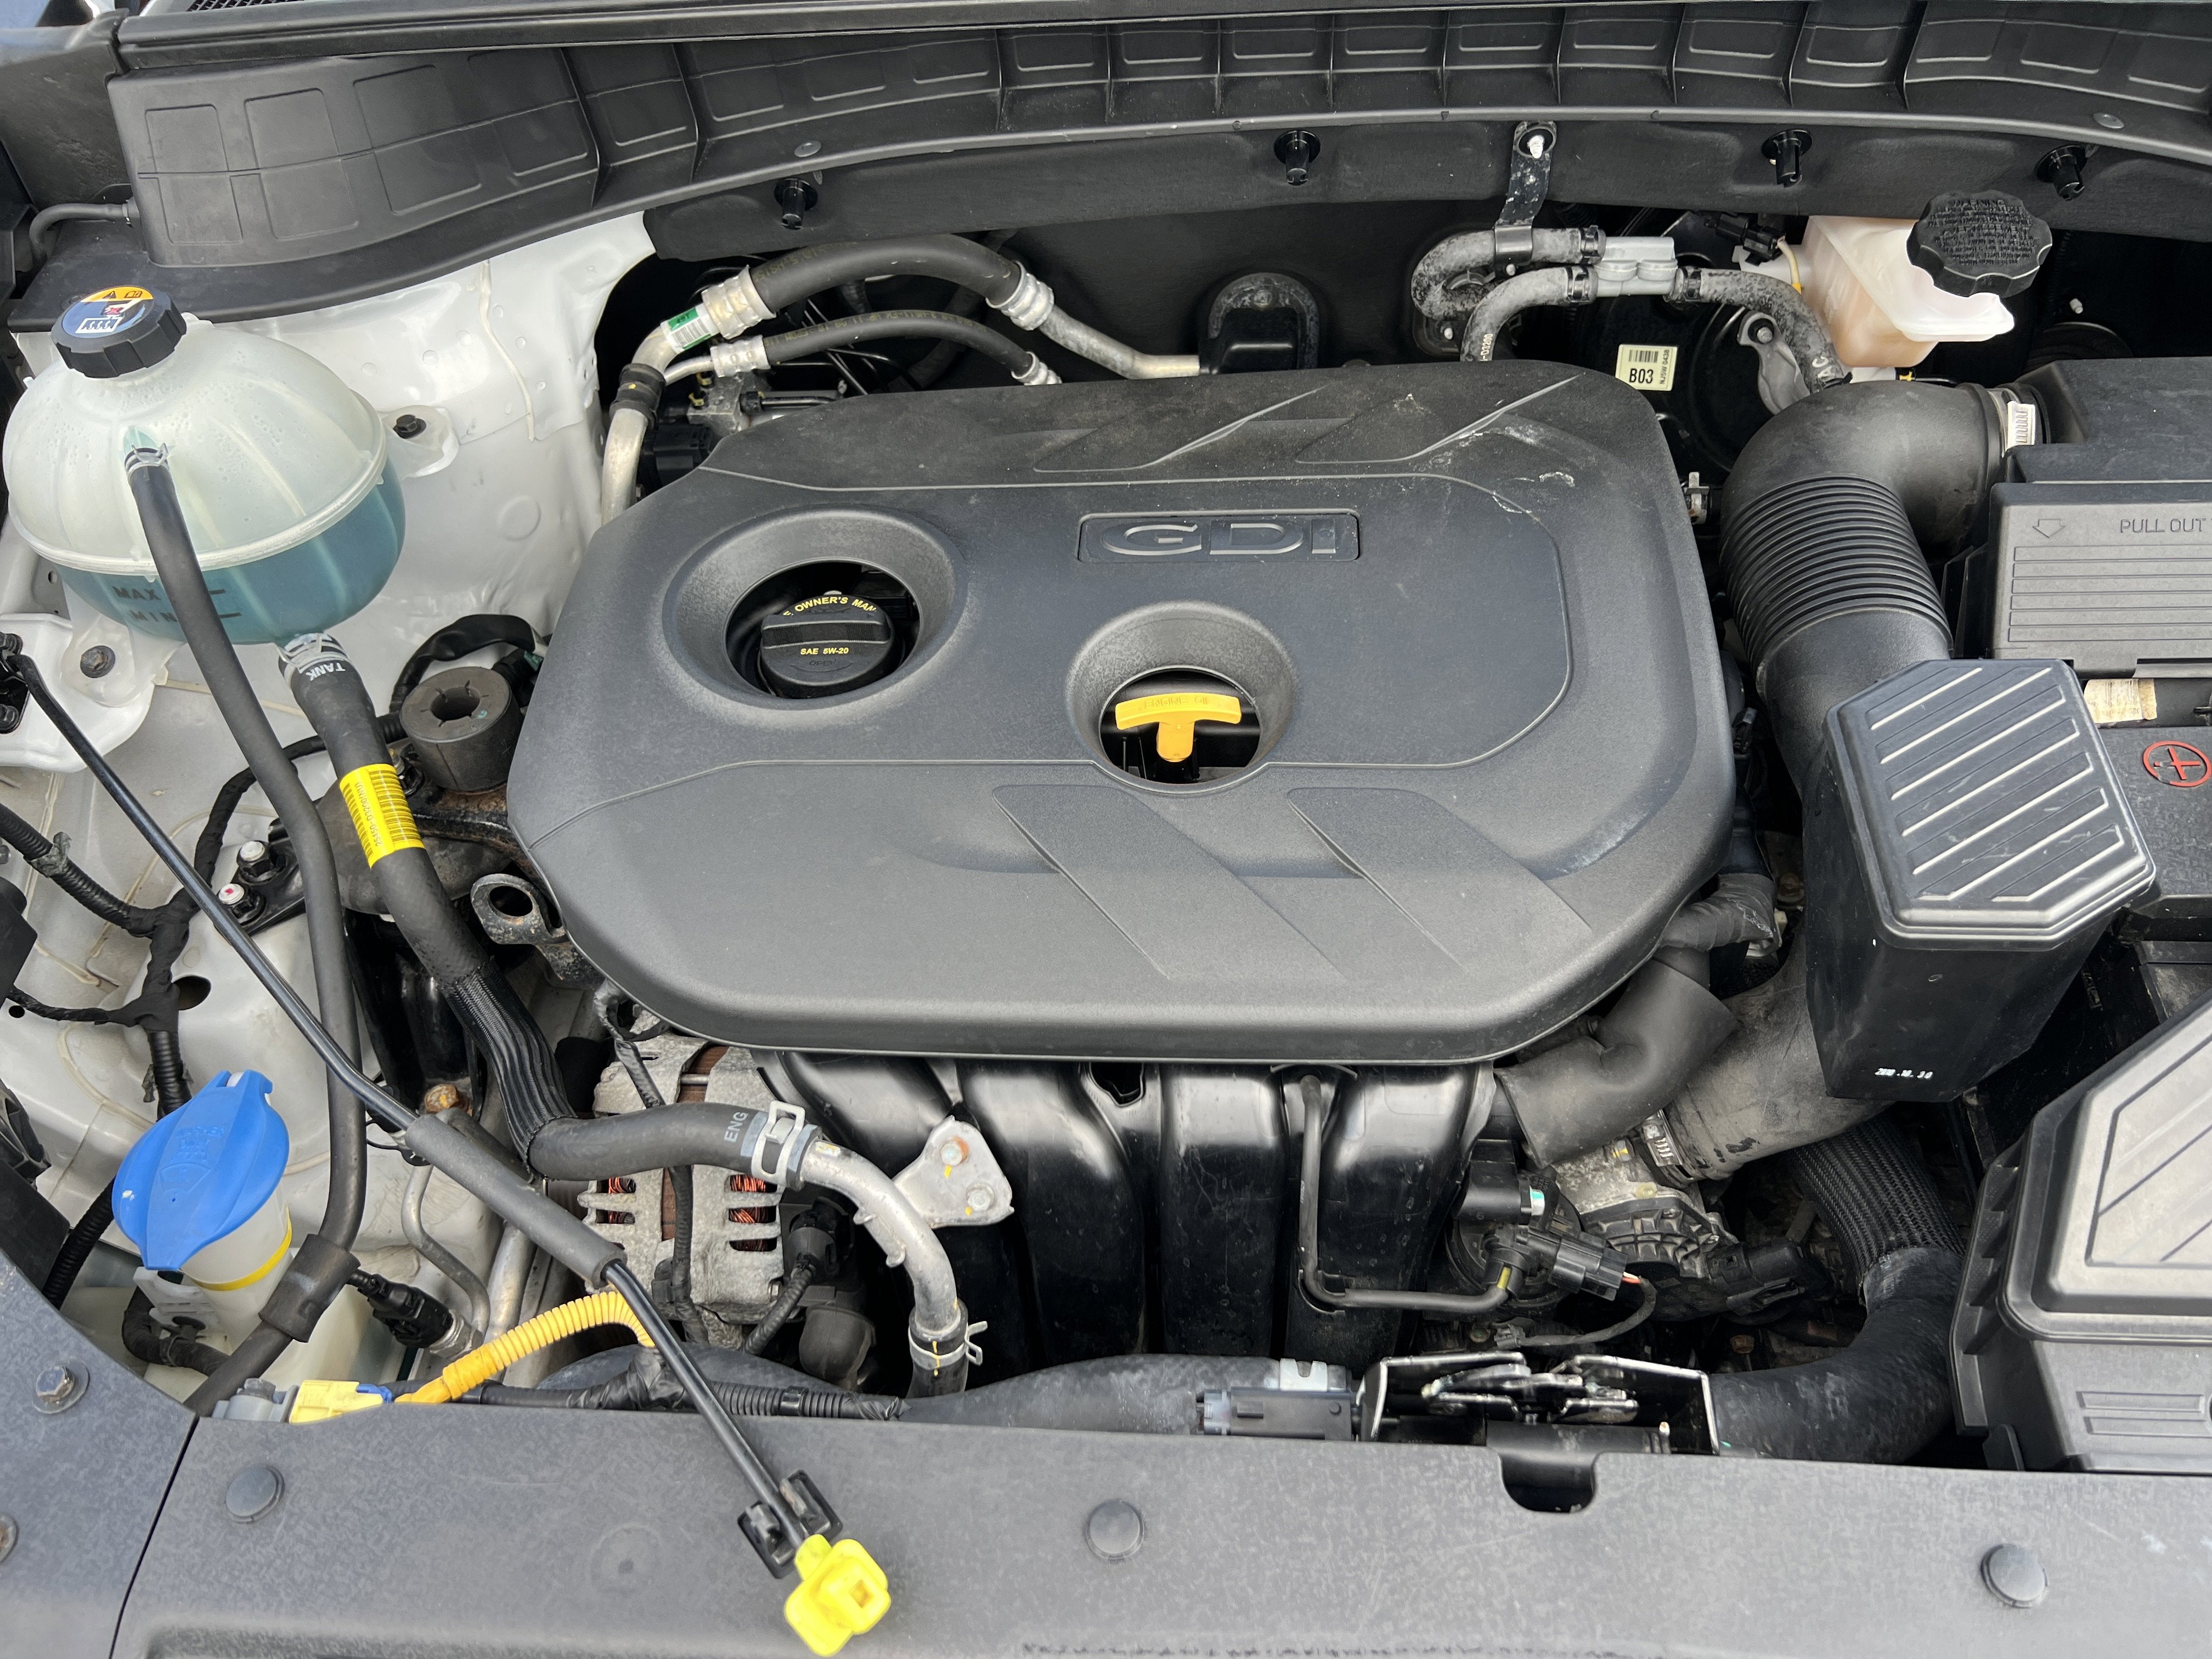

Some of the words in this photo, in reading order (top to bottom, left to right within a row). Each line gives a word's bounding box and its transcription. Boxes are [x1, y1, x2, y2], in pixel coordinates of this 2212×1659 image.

[1480, 334, 1493, 361] -D3200
[1629, 368, 1654, 384] B03
[2120, 519, 2165, 533] PULL
[2170, 518, 2206, 532] OUT
[112, 586, 161, 600] MAX
[795, 596, 849, 612] OWNER'S
[129, 610, 178, 622] MIN
[306, 662, 346, 681] TANK
[1145, 697, 1187, 708] ENGINE
[1194, 697, 1212, 706] OIL
[724, 1111, 748, 1142] ENG
